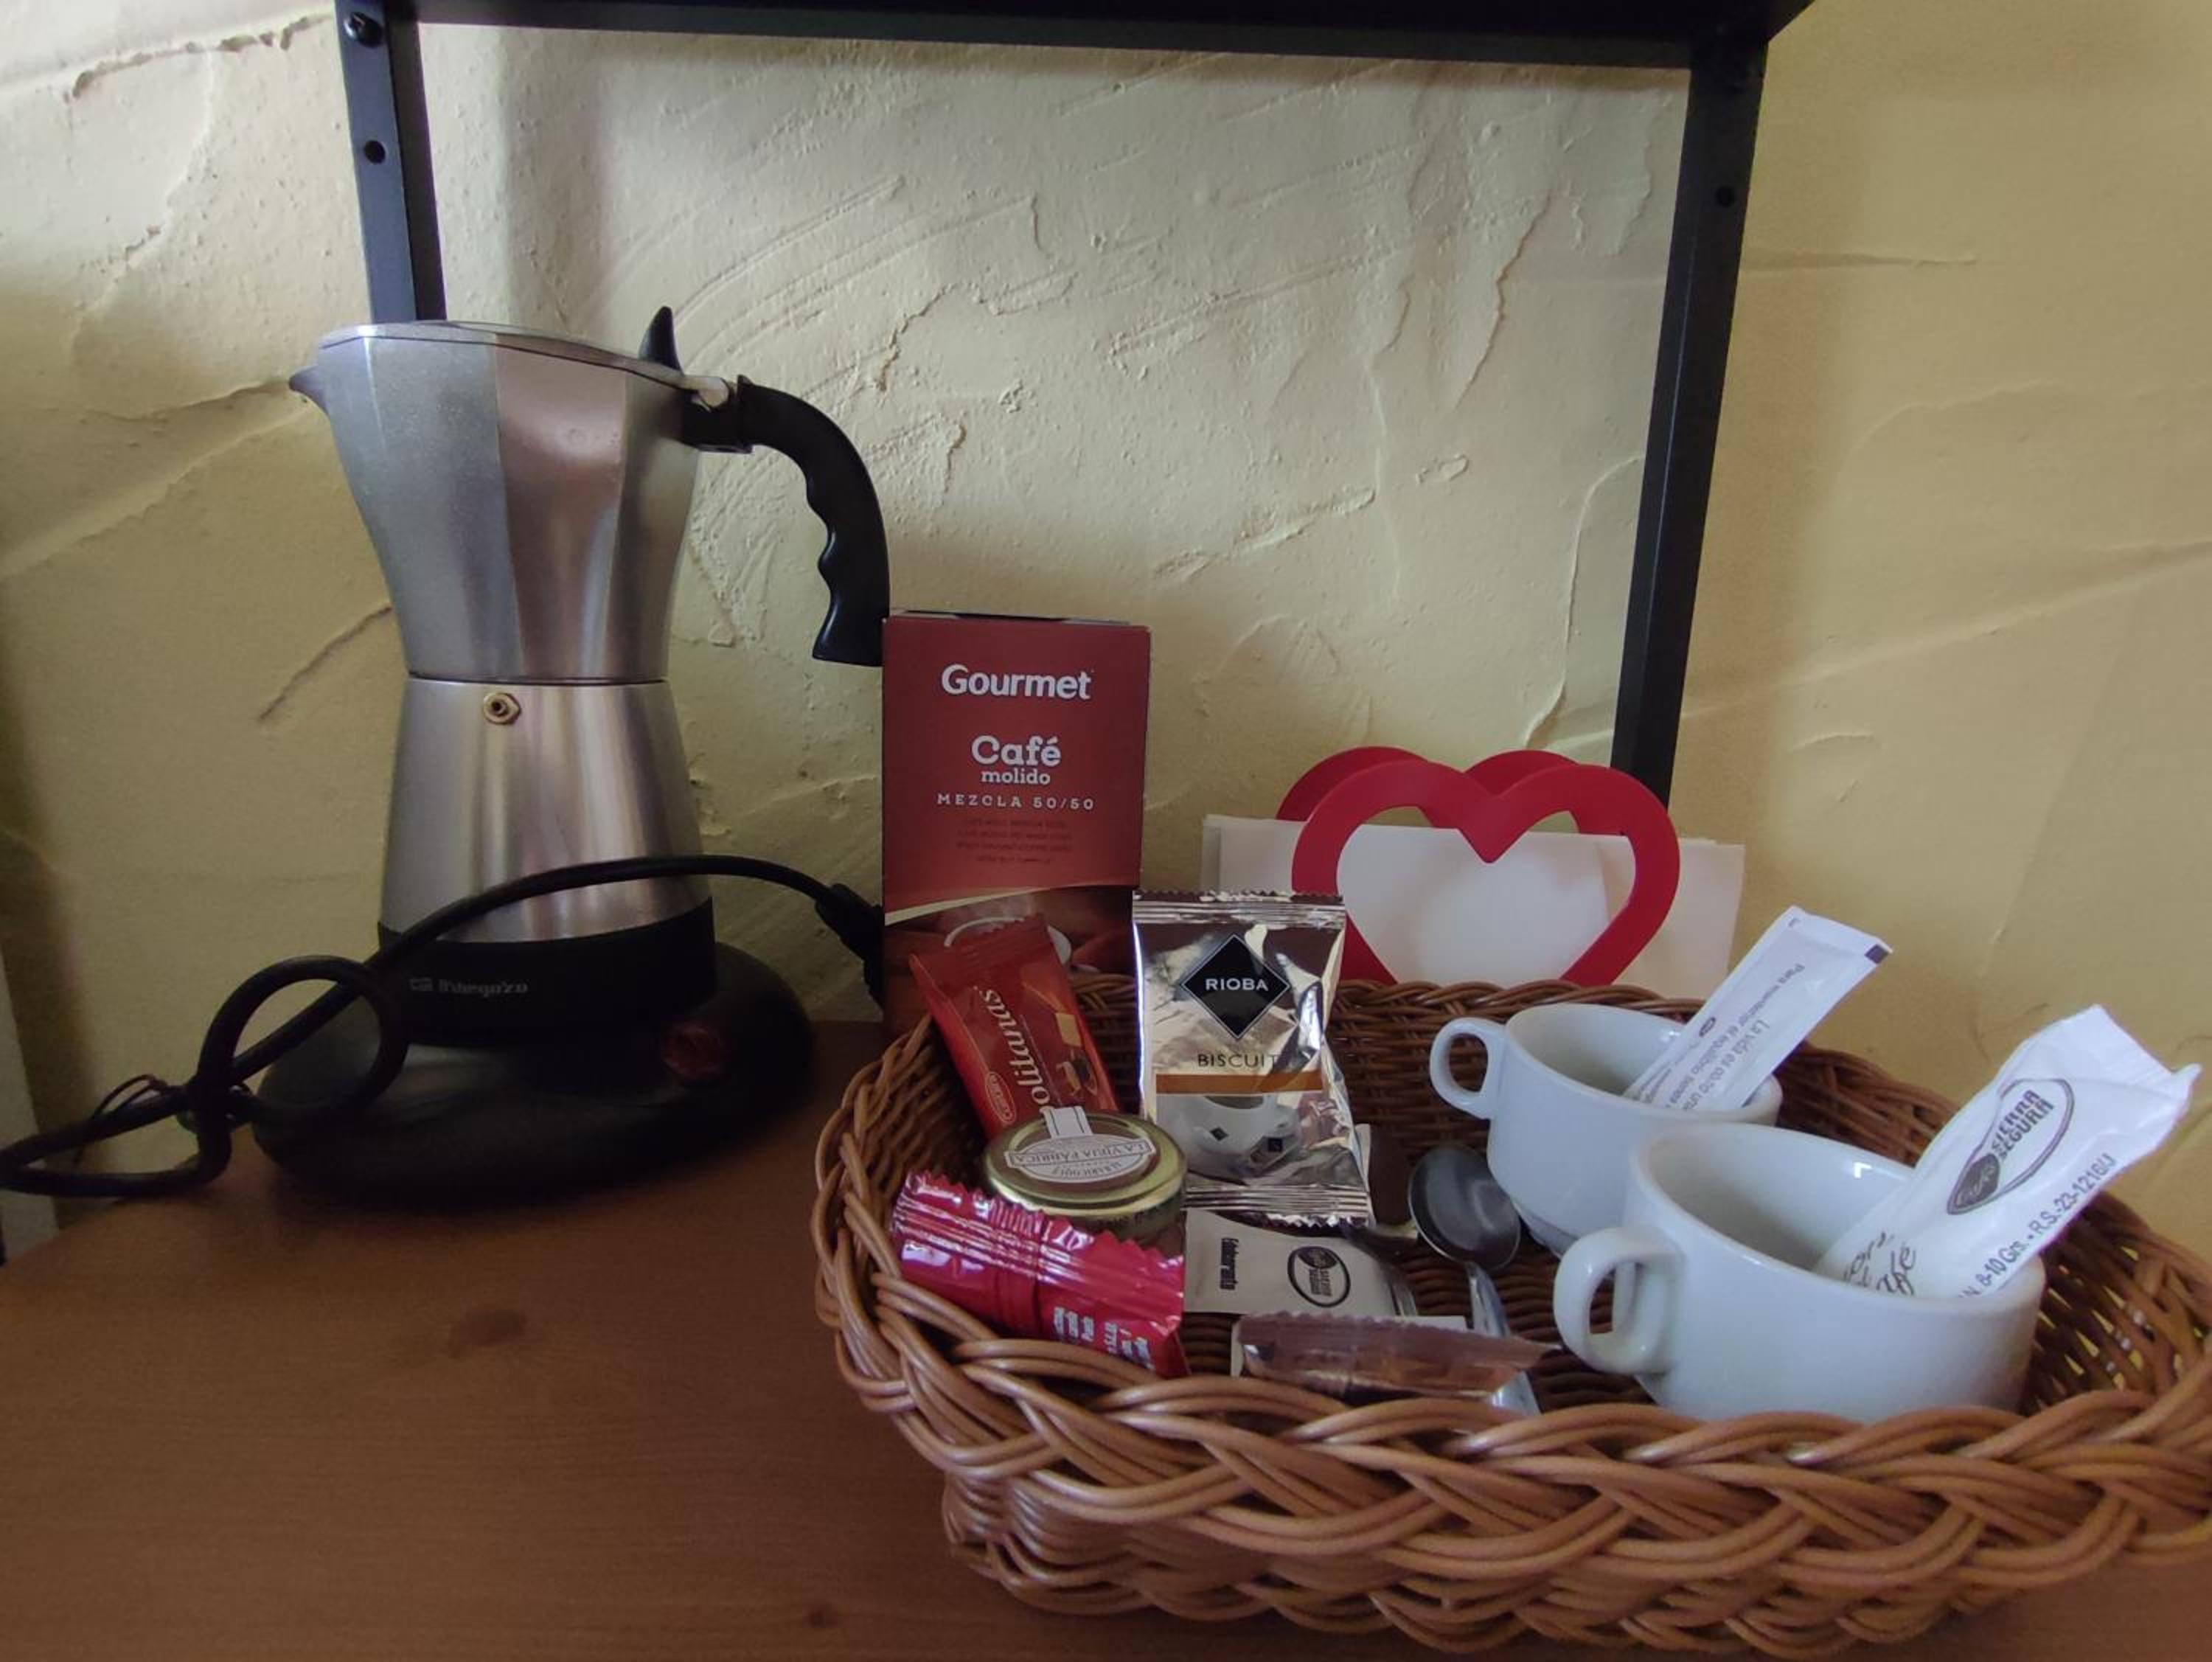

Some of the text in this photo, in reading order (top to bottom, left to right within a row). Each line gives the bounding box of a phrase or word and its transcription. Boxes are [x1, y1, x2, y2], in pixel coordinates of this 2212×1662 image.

[941, 663, 1092, 700] Gourmet
[971, 735, 1062, 767] Café
[981, 768, 1051, 785] molido
[936, 793, 1095, 810] MEZCLA 50/50
[1206, 978, 1269, 991] RIOBA
[983, 989, 1050, 1105] olitanas
[1197, 1053, 1281, 1068] BISCUIT
[1991, 1089, 2041, 1152] SIERRA
[1997, 1099, 2055, 1162] SEGURA
